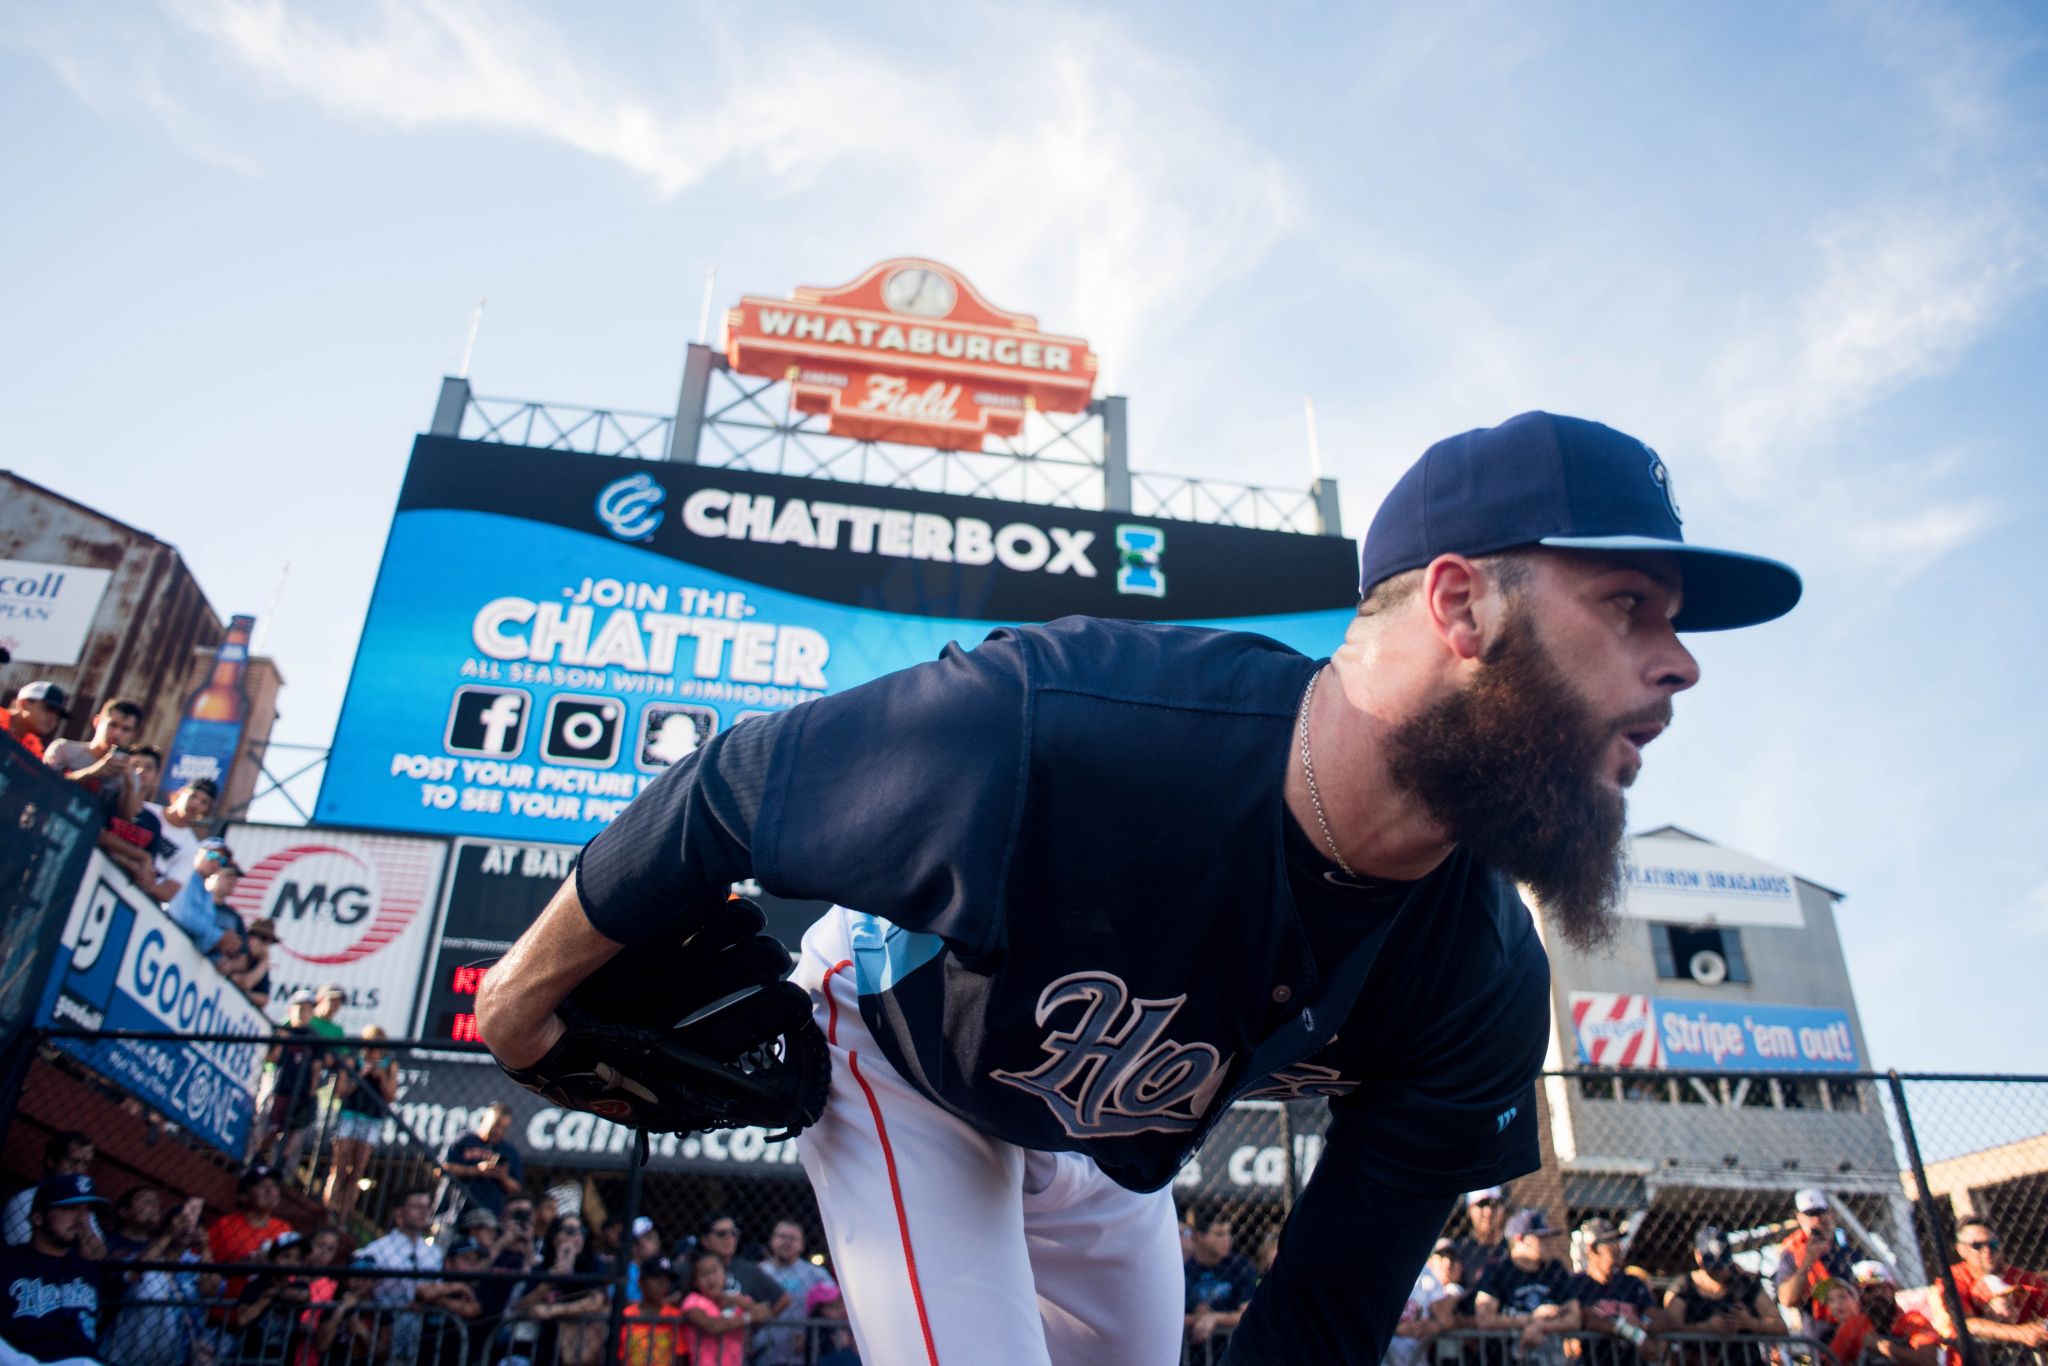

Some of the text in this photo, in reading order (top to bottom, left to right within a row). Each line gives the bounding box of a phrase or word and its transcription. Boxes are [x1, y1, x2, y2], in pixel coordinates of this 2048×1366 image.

[758, 308, 1072, 372] WHATABURGER
[858, 373, 961, 419] Field
[681, 488, 1098, 577] CHATTERBOX
[472, 596, 831, 689] CHATTER
[461, 659, 501, 680] ALL
[509, 663, 606, 689] SEASON
[612, 672, 675, 696] WITH
[391, 754, 457, 781] POST
[463, 760, 533, 788] YOUR
[537, 766, 634, 797] PICTURE
[422, 784, 457, 809] TO
[460, 786, 503, 814] SEE
[508, 791, 581, 820] YOUR
[482, 845, 579, 879] AT BAT
[1662, 1011, 1745, 1064] Stripe
[1744, 1015, 1797, 1059] 'em
[1799, 1021, 1854, 1062] out!
